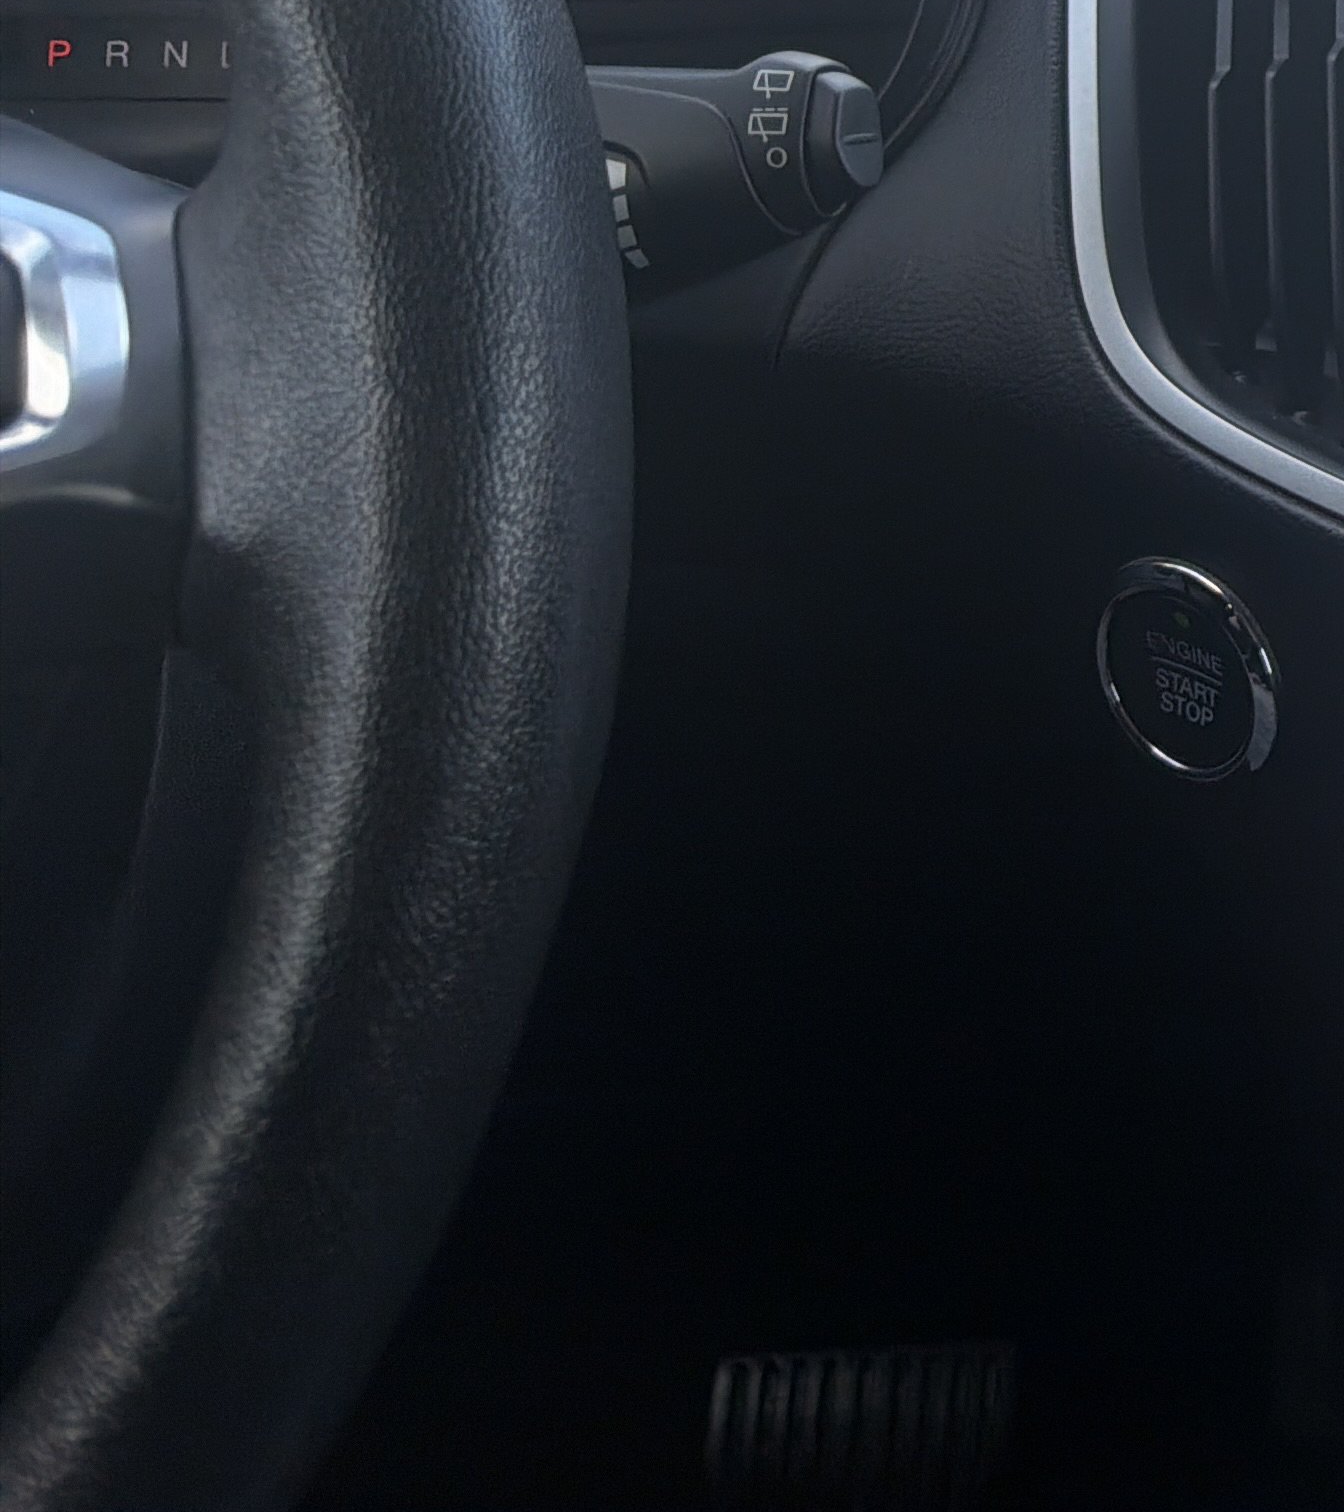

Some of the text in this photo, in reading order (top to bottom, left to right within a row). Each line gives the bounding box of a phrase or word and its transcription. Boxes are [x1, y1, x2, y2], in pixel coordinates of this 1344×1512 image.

[47, 39, 72, 68] P
[105, 39, 130, 68] R
[163, 39, 188, 68] N
[1146, 630, 1223, 677] ENGINE
[1155, 668, 1220, 707] START
[1160, 691, 1214, 727] STOP
